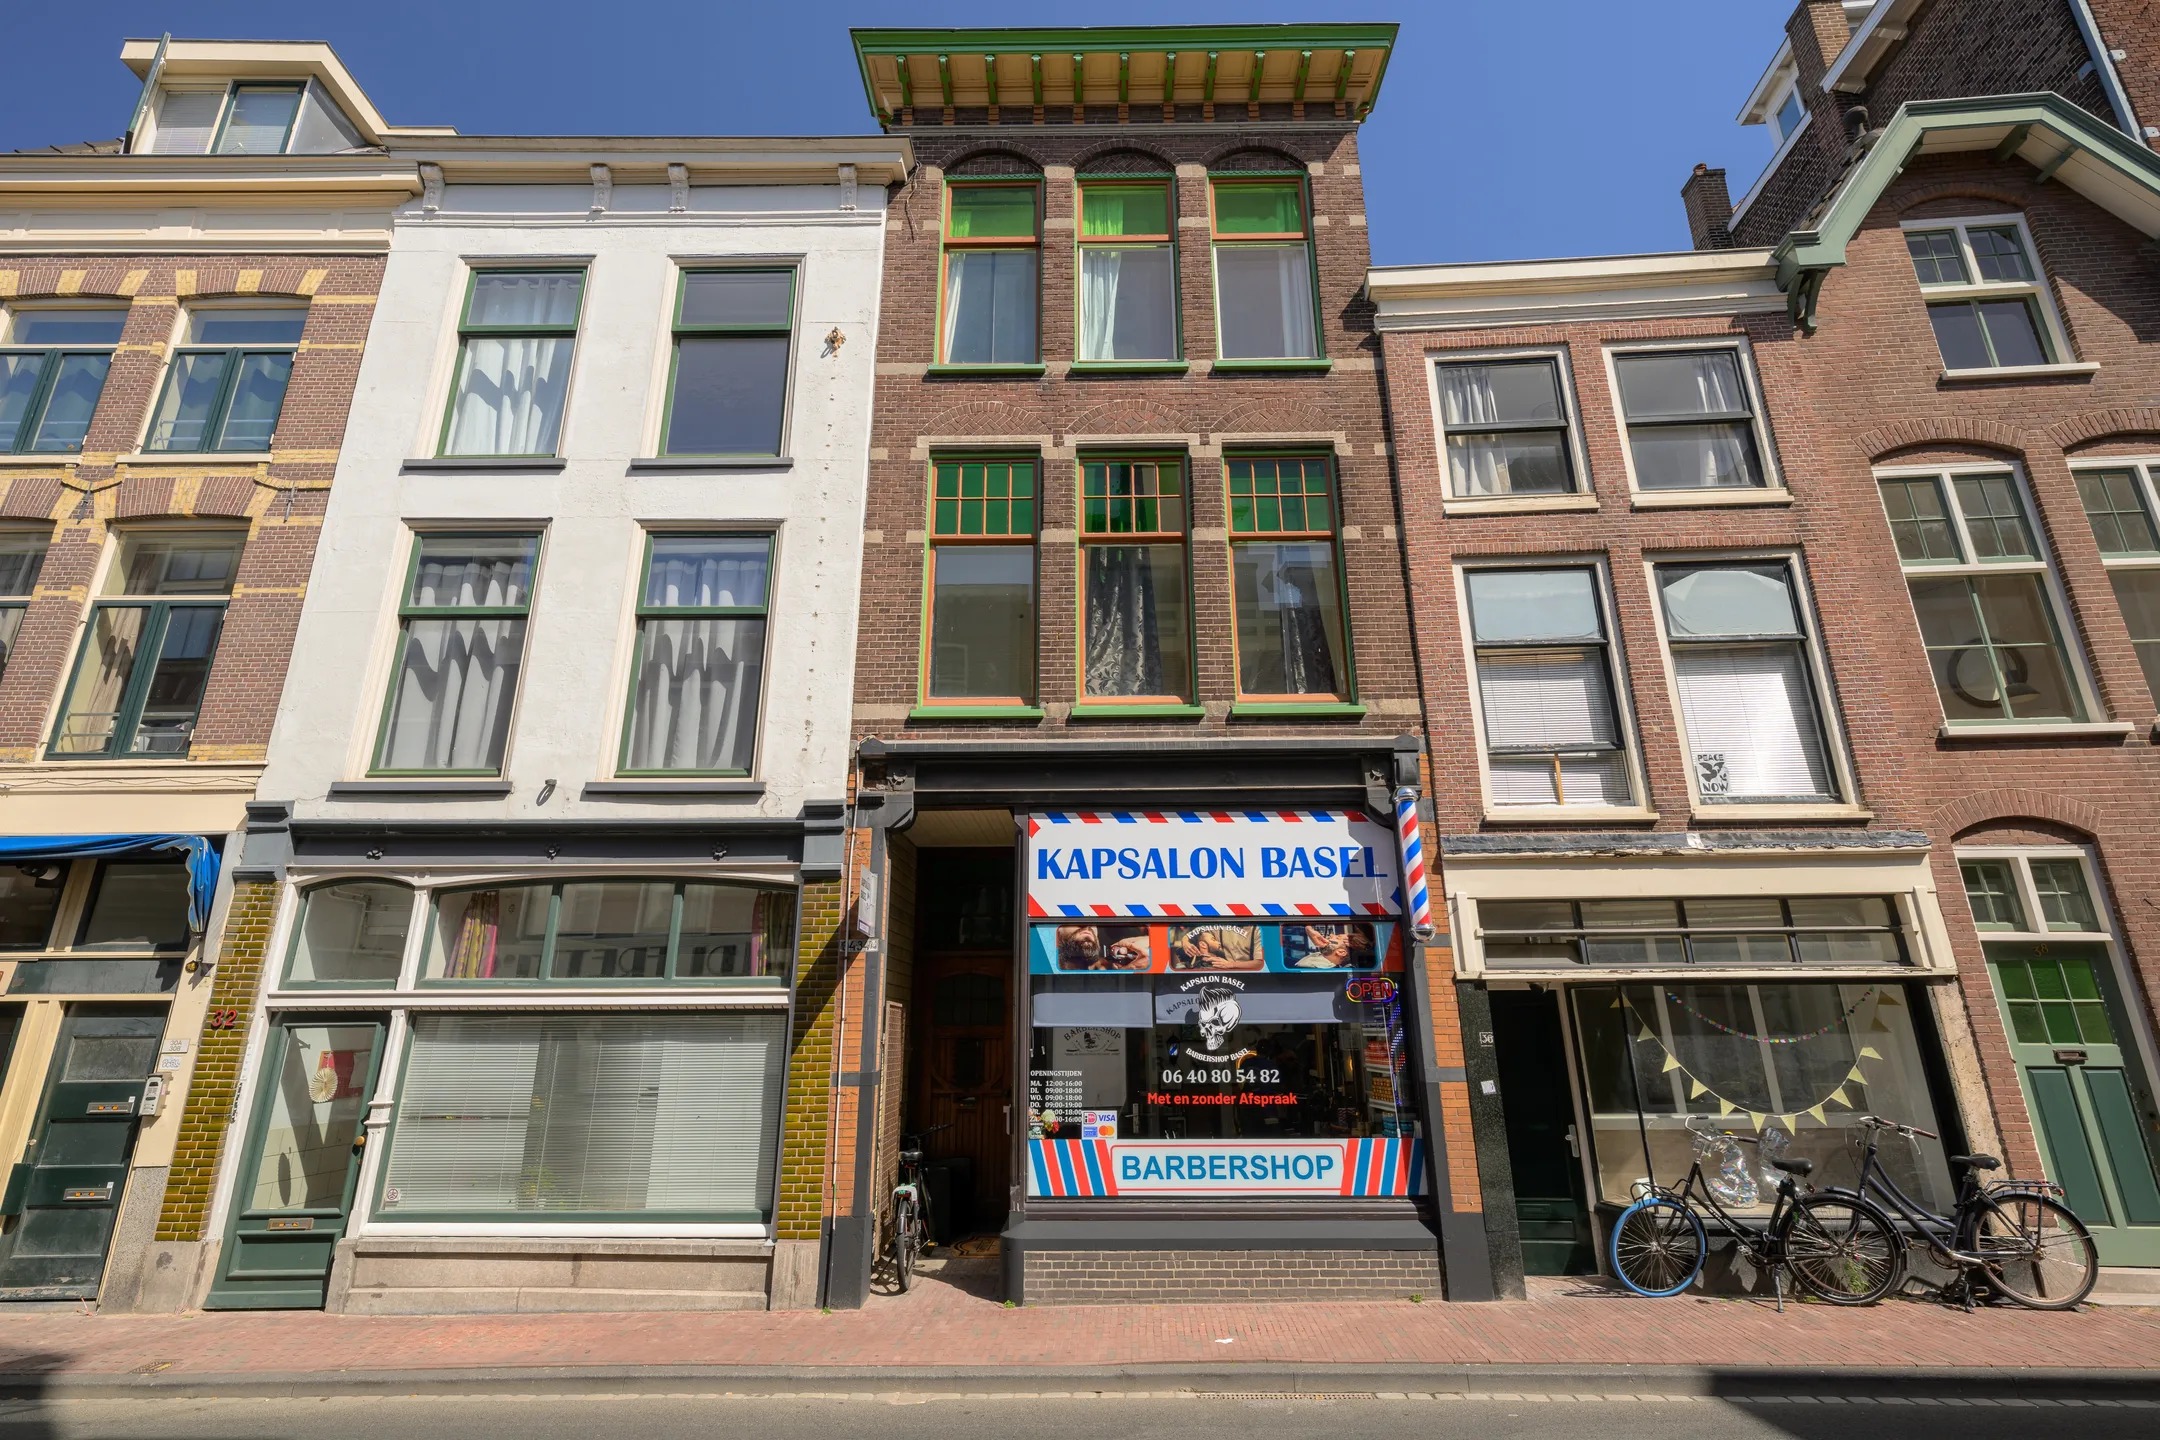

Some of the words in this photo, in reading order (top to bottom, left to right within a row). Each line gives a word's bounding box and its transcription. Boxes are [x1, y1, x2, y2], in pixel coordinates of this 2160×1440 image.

[1697, 753, 1724, 762] PEACE
[1702, 782, 1729, 792] NOW
[1037, 847, 1245, 880] KAPSALON
[1260, 846, 1388, 878] BASEL
[1226, 924, 1249, 939] BASEL
[1180, 975, 1220, 992] KAPSALON
[1221, 976, 1246, 991] BASEL
[1348, 982, 1393, 999] OPEN
[211, 1009, 238, 1028] 32
[1482, 1034, 1493, 1043] 36
[1185, 1047, 1230, 1063] BARBERSHOP
[1230, 1047, 1250, 1061] BASEL
[1162, 1069, 1183, 1083] 06
[1187, 1069, 1207, 1083] 40
[1211, 1069, 1232, 1083] 80
[1235, 1069, 1257, 1083] 54
[1259, 1069, 1281, 1083] 82
[1147, 1092, 1171, 1105] Met
[1173, 1095, 1190, 1105] en
[1192, 1092, 1237, 1105] zonder
[1239, 1092, 1298, 1107] Afspraak
[1098, 1114, 1116, 1122] VISA
[1122, 1155, 1334, 1180] BARBERSHOP
